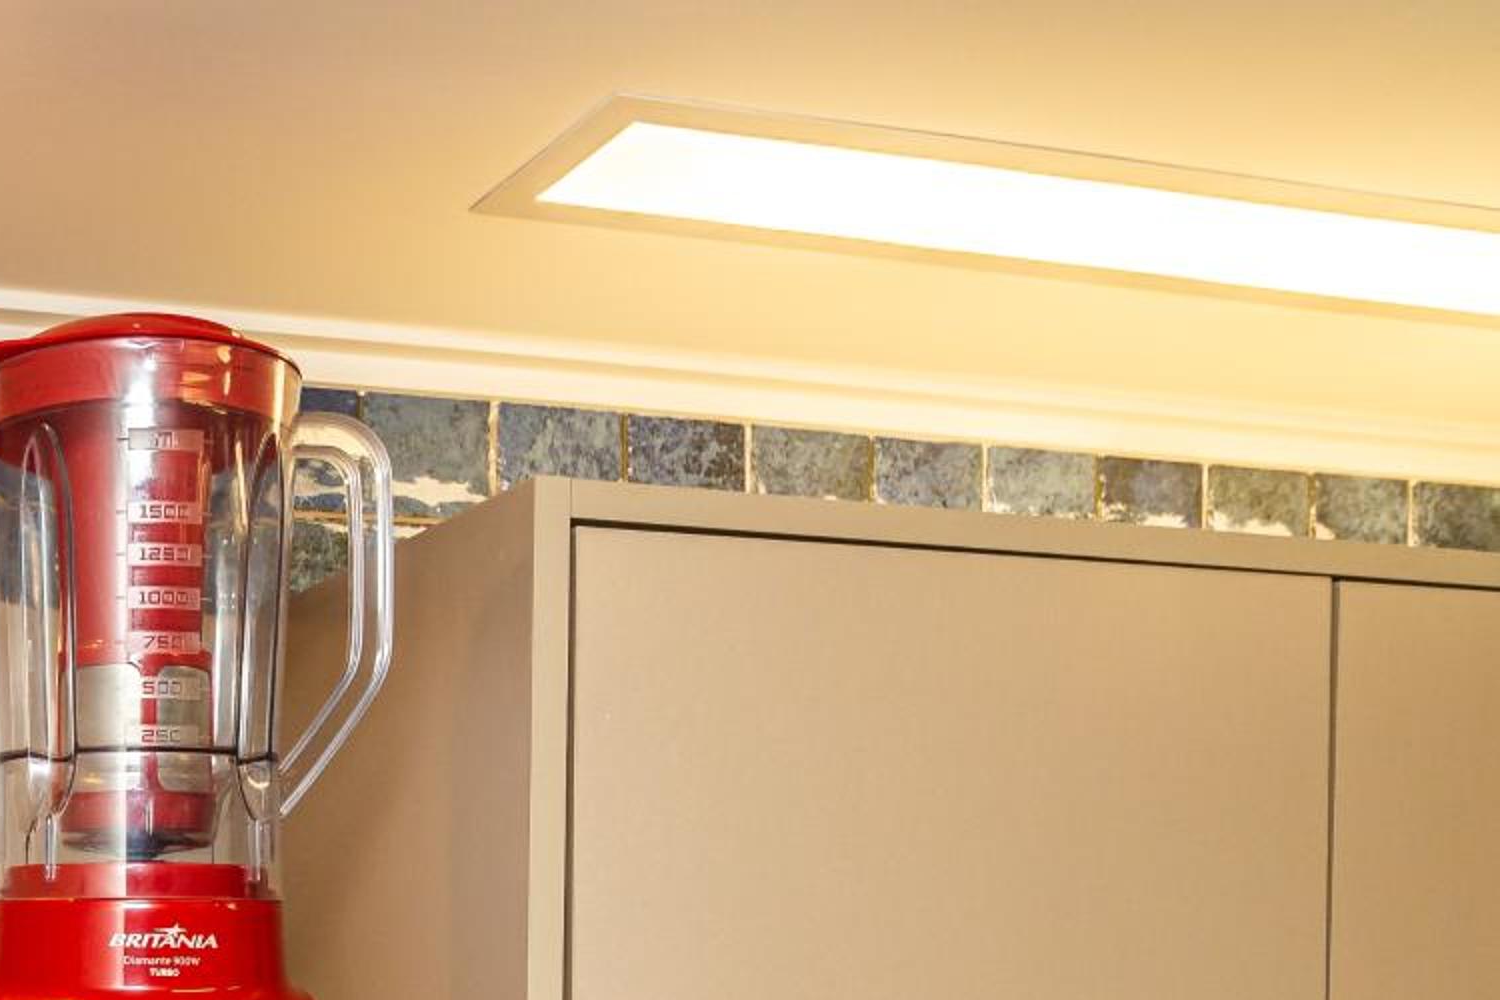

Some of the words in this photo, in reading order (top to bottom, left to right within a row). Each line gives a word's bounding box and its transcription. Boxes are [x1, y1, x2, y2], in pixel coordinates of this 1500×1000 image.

[140, 592, 188, 604] 1000
[143, 636, 184, 648] 750
[142, 681, 180, 694] 500
[142, 730, 180, 742] 250
[122, 955, 171, 966] Diamante
[149, 968, 180, 977] TURBO
